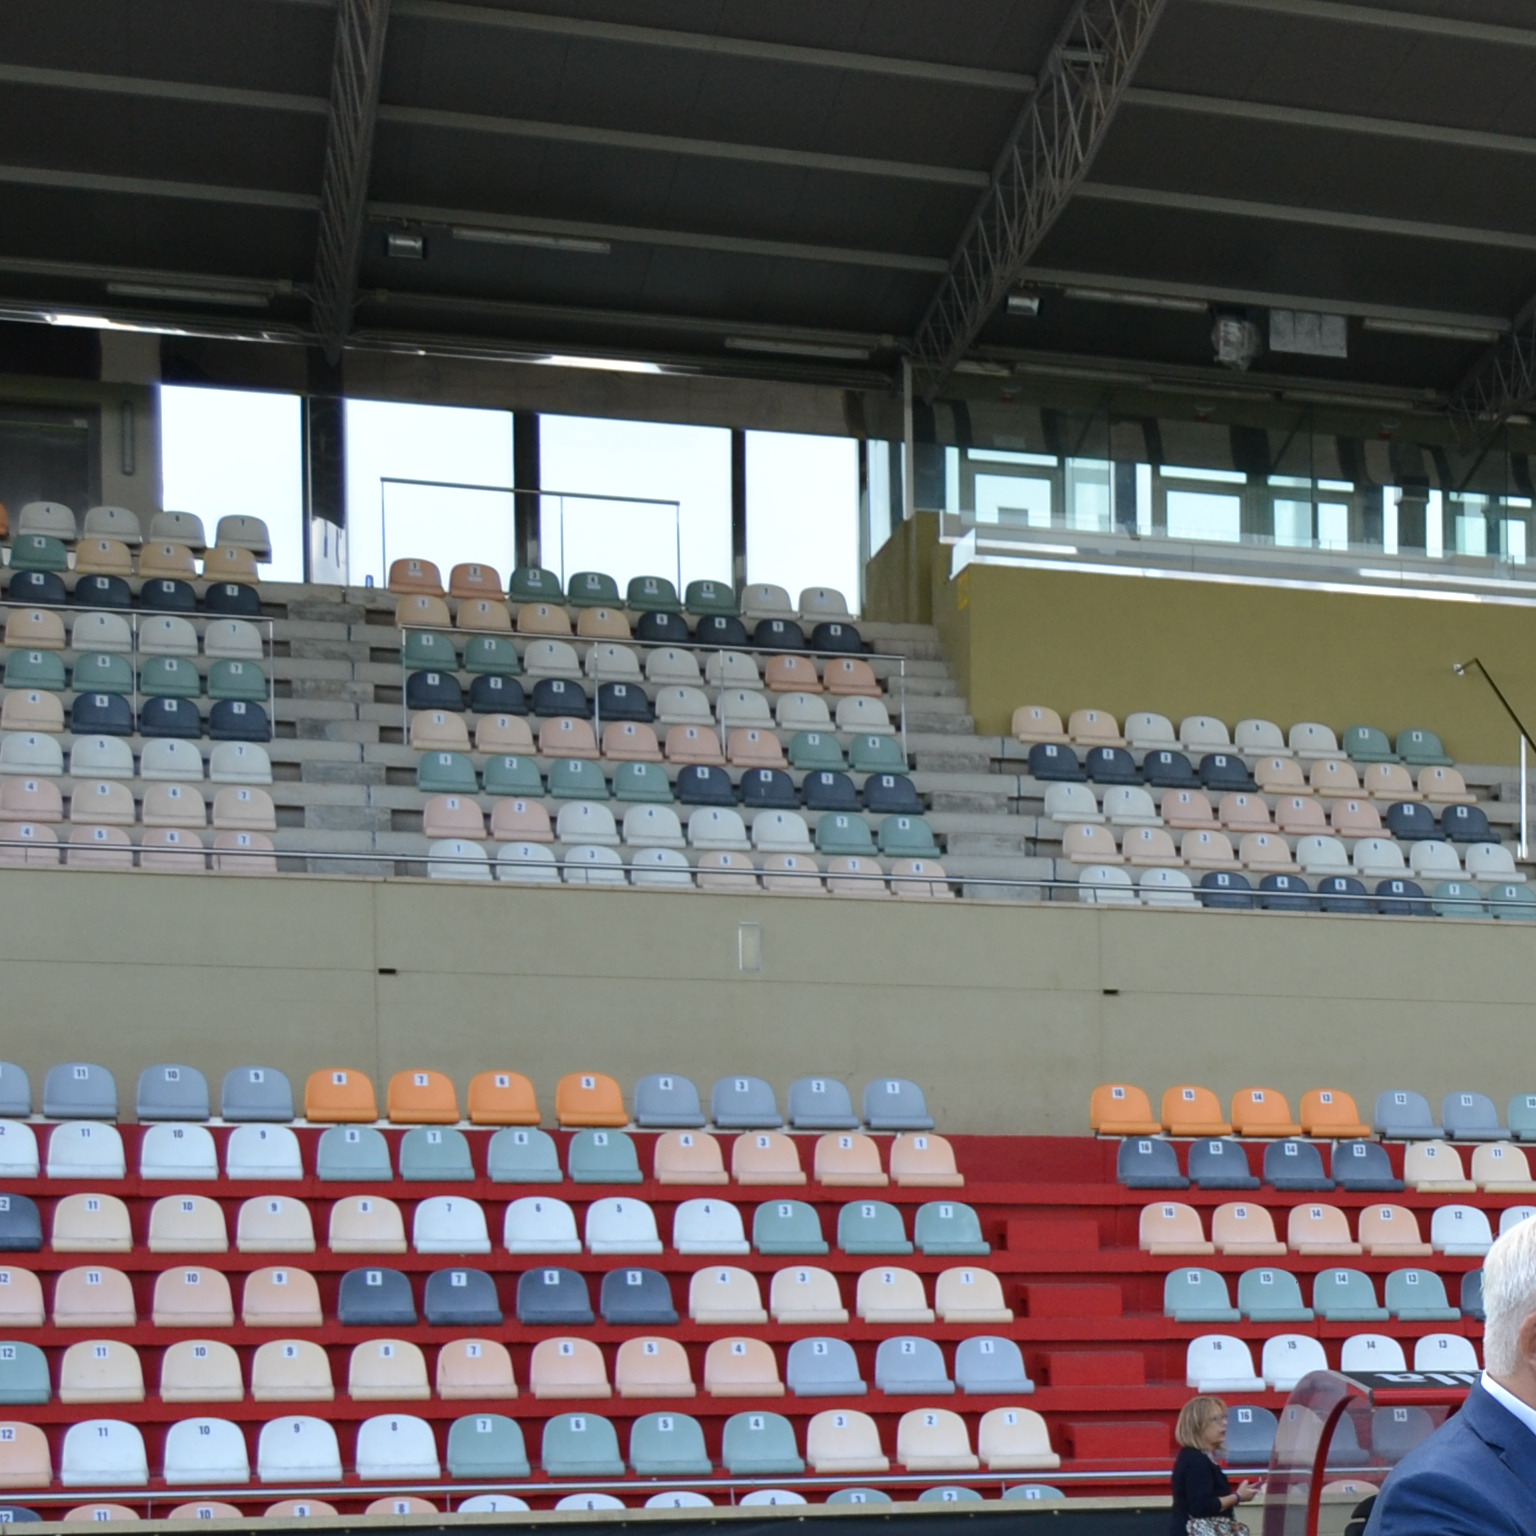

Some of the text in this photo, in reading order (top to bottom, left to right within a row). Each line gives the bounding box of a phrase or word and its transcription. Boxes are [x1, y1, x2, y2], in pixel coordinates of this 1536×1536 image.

[76, 1068, 87, 1078] 11
[167, 1070, 178, 1080] 10
[253, 1071, 261, 1081] 9
[336, 1074, 344, 1084] 8
[417, 1074, 425, 1085] 7
[498, 1076, 506, 1086] 6
[584, 1077, 592, 1088] 5
[662, 1079, 670, 1089] 4
[738, 1081, 746, 1091] 3
[815, 1081, 822, 1092] 2
[890, 1083, 896, 1093] 1
[80, 1127, 91, 1138] 11
[172, 1128, 184, 1139] 10
[259, 1129, 267, 1140] 9
[349, 1131, 356, 1142] 8
[430, 1132, 437, 1143] 7
[517, 1133, 525, 1143] 6
[597, 1134, 605, 1145] 5
[682, 1135, 690, 1145] 4
[759, 1137, 767, 1147] 3
[842, 1137, 849, 1148] 2
[918, 1138, 924, 1148] 1
[87, 1199, 98, 1211] 11
[182, 1201, 194, 1211] 10
[270, 1202, 278, 1213] 9
[361, 1201, 369, 1212] 8
[445, 1202, 453, 1213] 7
[535, 1202, 542, 1213] 6
[616, 1203, 623, 1214] 5
[703, 1204, 711, 1214] 4
[782, 1205, 789, 1216] 3
[865, 1206, 872, 1217] 2
[944, 1207, 949, 1217] 1
[88, 1272, 99, 1284] 11
[186, 1272, 199, 1284] 10
[275, 1272, 284, 1283] 9
[370, 1273, 378, 1284] 8
[455, 1273, 462, 1285] 7
[547, 1272, 555, 1283] 6
[630, 1272, 638, 1283] 5
[719, 1272, 727, 1283] 4
[799, 1272, 807, 1283] 3
[885, 1273, 892, 1284] 2
[964, 1273, 970, 1283] 1
[1, 1347, 14, 1359] 12
[95, 1346, 107, 1358] 11
[194, 1346, 207, 1357] 10
[286, 1346, 294, 1357] 9
[383, 1345, 391, 1357] 8
[470, 1345, 477, 1356] 7
[562, 1343, 570, 1354] 6
[646, 1343, 655, 1354] 5
[735, 1343, 742, 1354] 4
[817, 1343, 824, 1354] 3
[905, 1342, 912, 1353] 2
[984, 1342, 990, 1353] 1
[662, 1418, 670, 1430] 5
[753, 1418, 761, 1428] 4
[836, 1416, 844, 1427] 3
[927, 1414, 934, 1426] 2
[1007, 1413, 1014, 1424] 1
[198, 1424, 211, 1436] 10
[293, 1422, 301, 1434] 9
[390, 1421, 399, 1432] 8
[480, 1420, 488, 1431] 7
[574, 1419, 582, 1430] 6
[0, 1428, 14, 1440] 12
[97, 1426, 109, 1438] 11
[96, 1511, 108, 1522] 11
[198, 1508, 211, 1520] 10
[298, 1506, 306, 1518] 9
